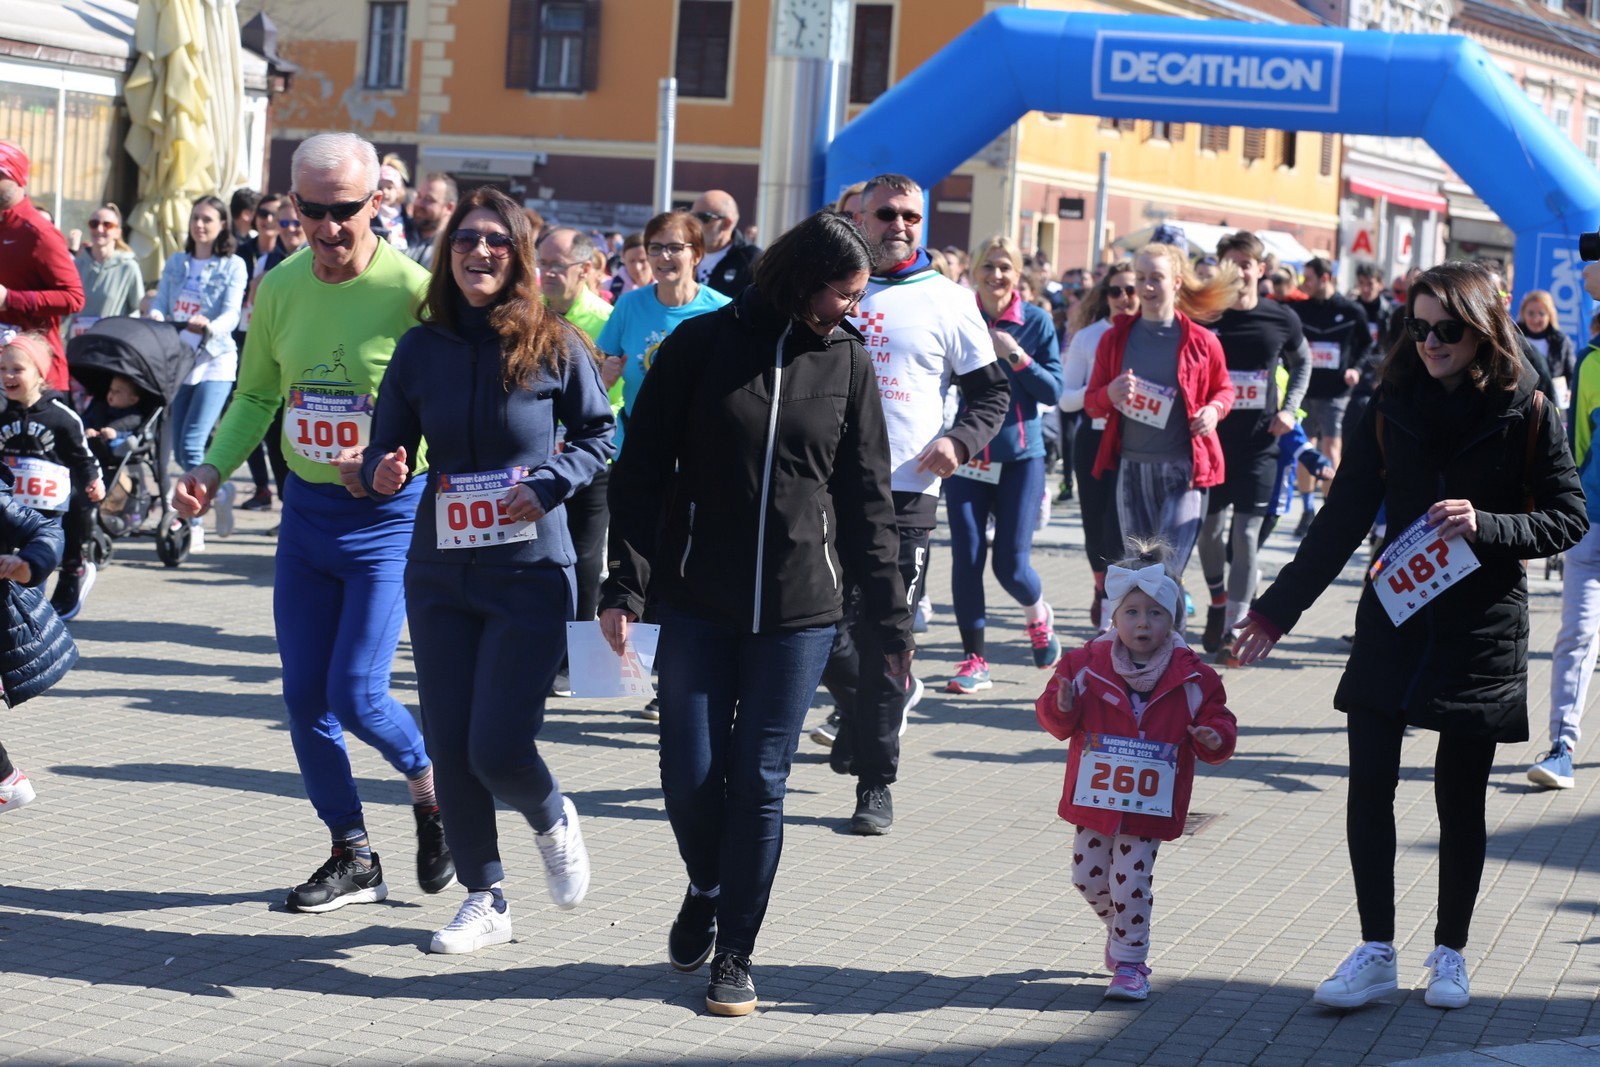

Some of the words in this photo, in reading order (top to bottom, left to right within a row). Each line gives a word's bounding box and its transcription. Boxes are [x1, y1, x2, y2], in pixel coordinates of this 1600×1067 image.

[1109, 49, 1323, 92] DECATHLON
[1352, 230, 1372, 254] A
[863, 334, 890, 347] EEP
[879, 389, 911, 402] SOME
[1234, 385, 1258, 400] 16
[297, 418, 359, 447] 100
[15, 476, 58, 498] 162
[1387, 537, 1450, 595] 487
[1090, 762, 1160, 797] 260
